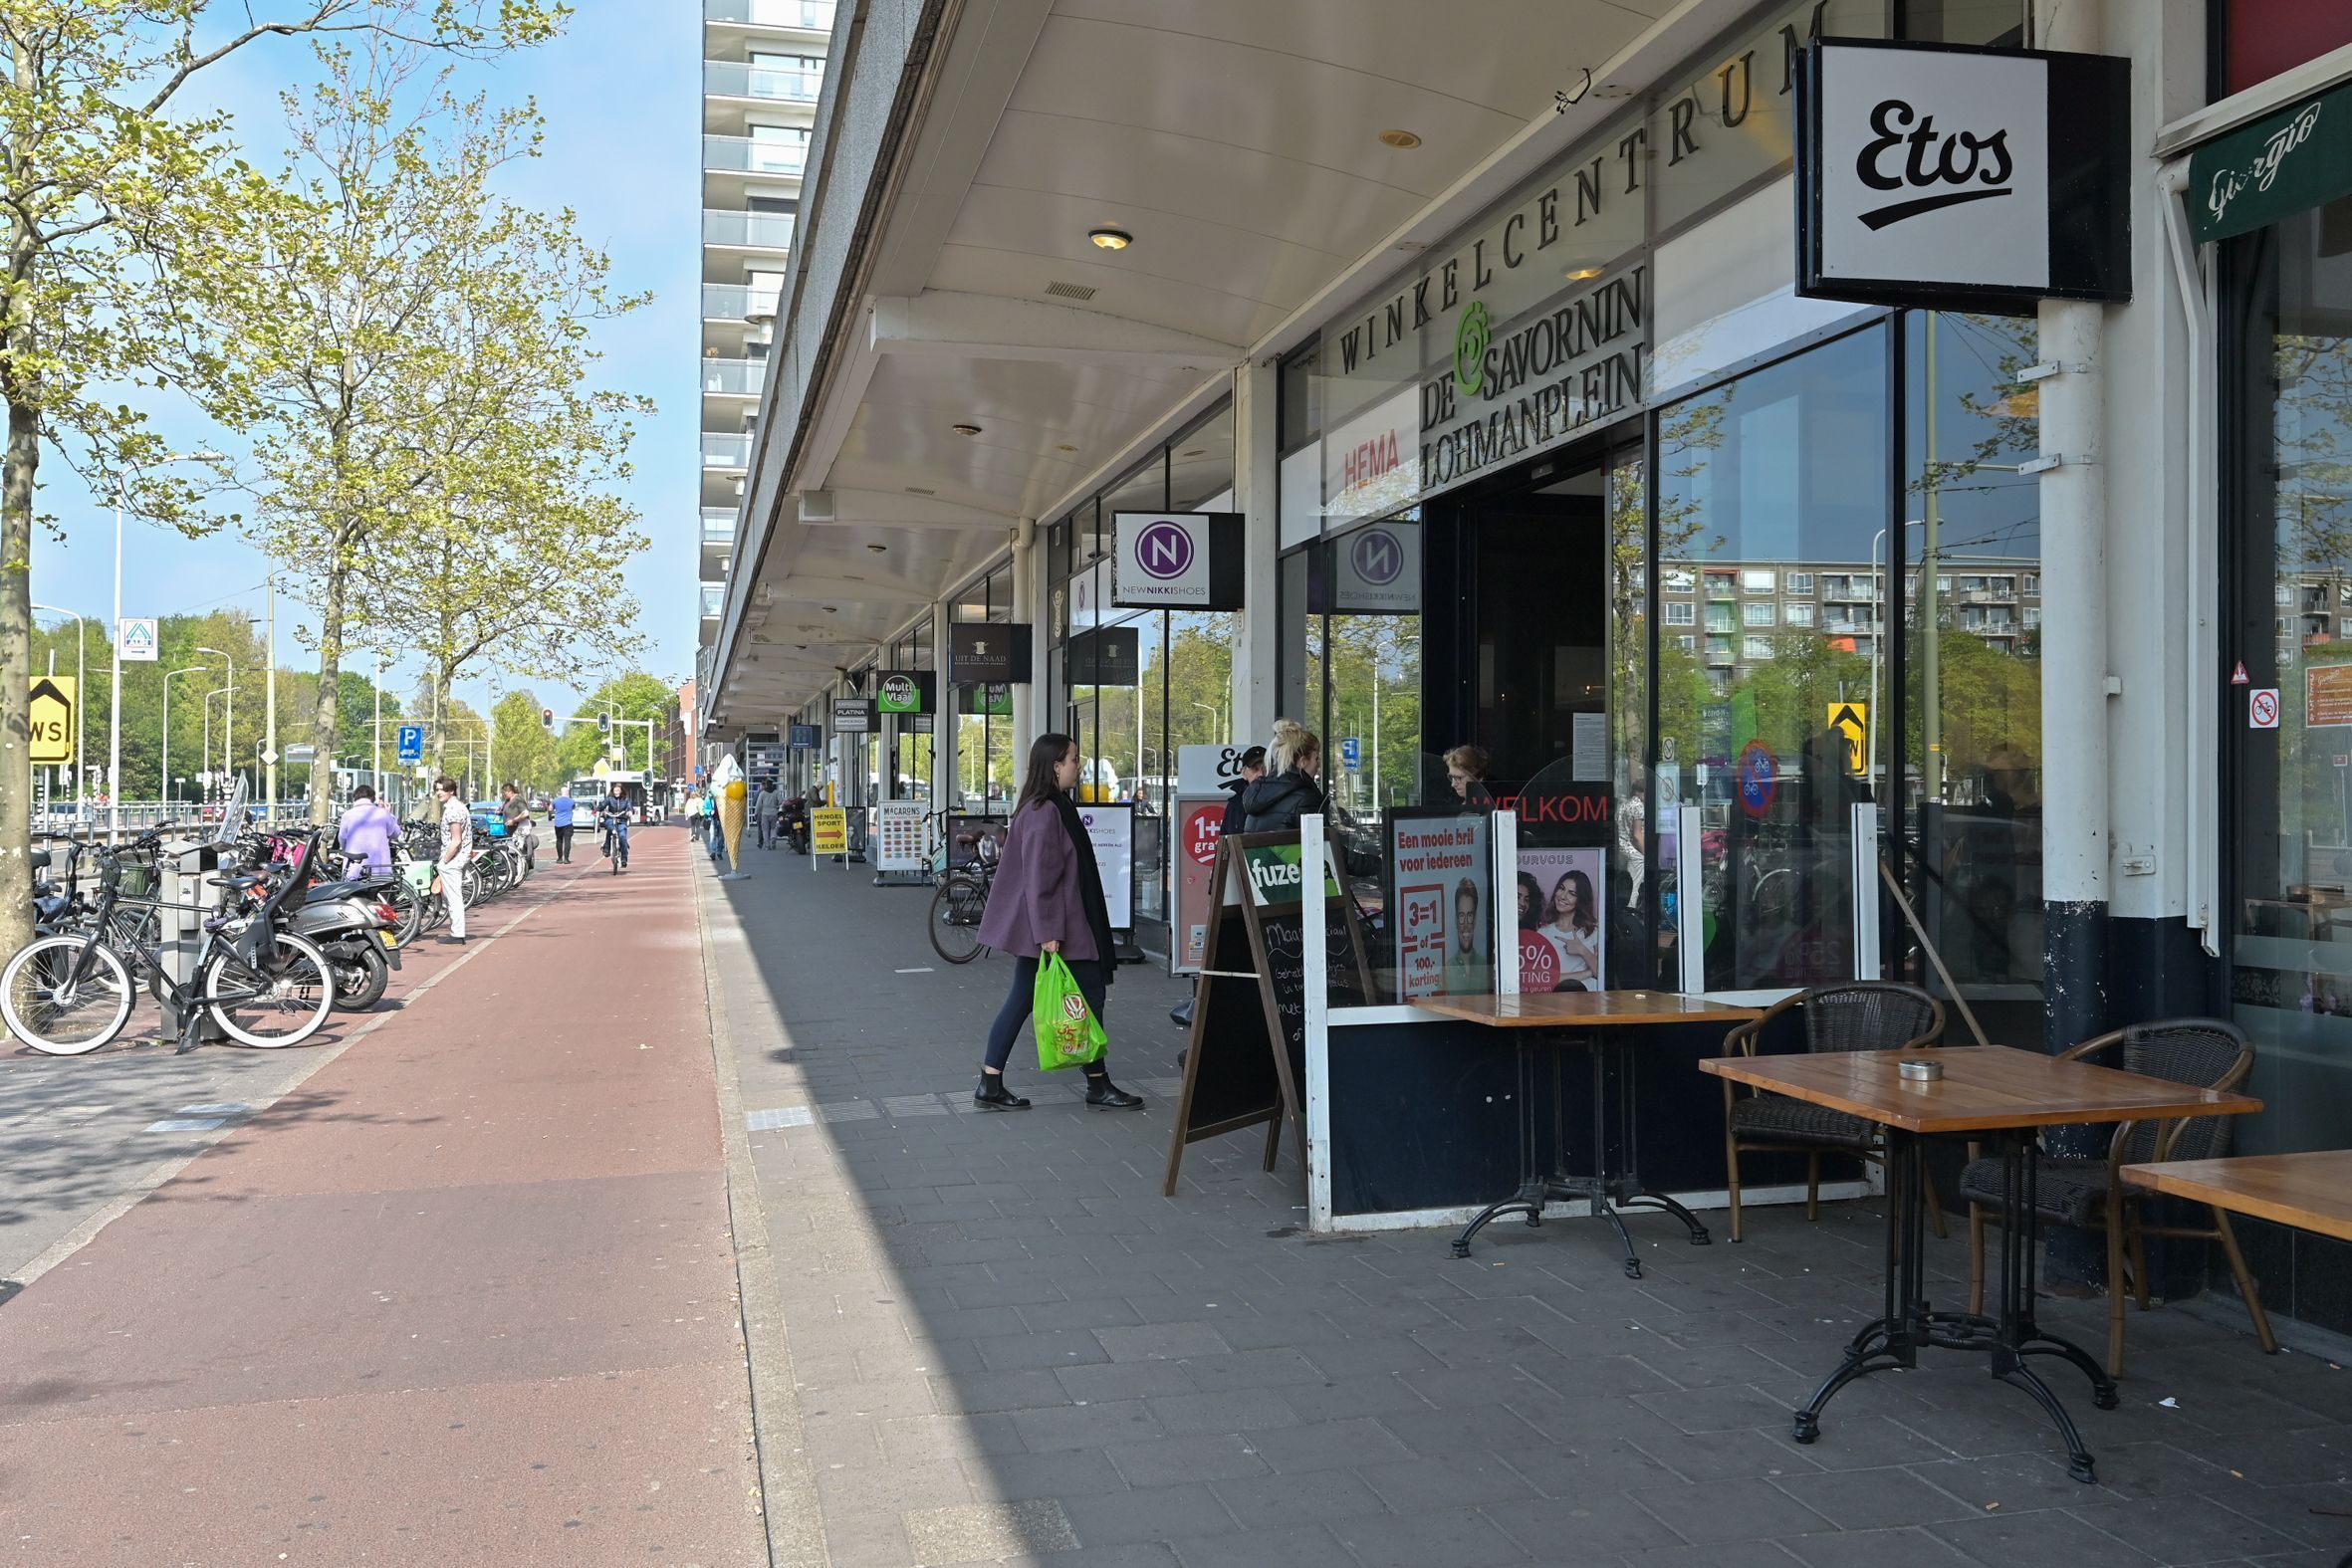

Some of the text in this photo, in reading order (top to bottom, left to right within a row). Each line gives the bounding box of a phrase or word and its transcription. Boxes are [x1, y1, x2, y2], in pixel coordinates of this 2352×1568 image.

[1856, 100, 2012, 191] Etos
[1421, 266, 1646, 433] DE SAVORNIN
[1421, 342, 1646, 492] LOHMANPLEIN
[1344, 429, 1399, 495] HEMA
[1152, 535, 1177, 566] N
[1123, 585, 1206, 596] NEWNIKKISHOES
[886, 682, 912, 692] Multi
[887, 692, 912, 702] Vlaai
[404, 728, 416, 746] P
[884, 806, 920, 815] MACARONS
[1398, 828, 1474, 848] Een mooie bril
[1400, 852, 1473, 872] voor iedereen
[1253, 859, 1300, 888] fuze
[1409, 900, 1437, 927] 3=1
[1420, 935, 1429, 949] of
[1409, 971, 1440, 989] korting
